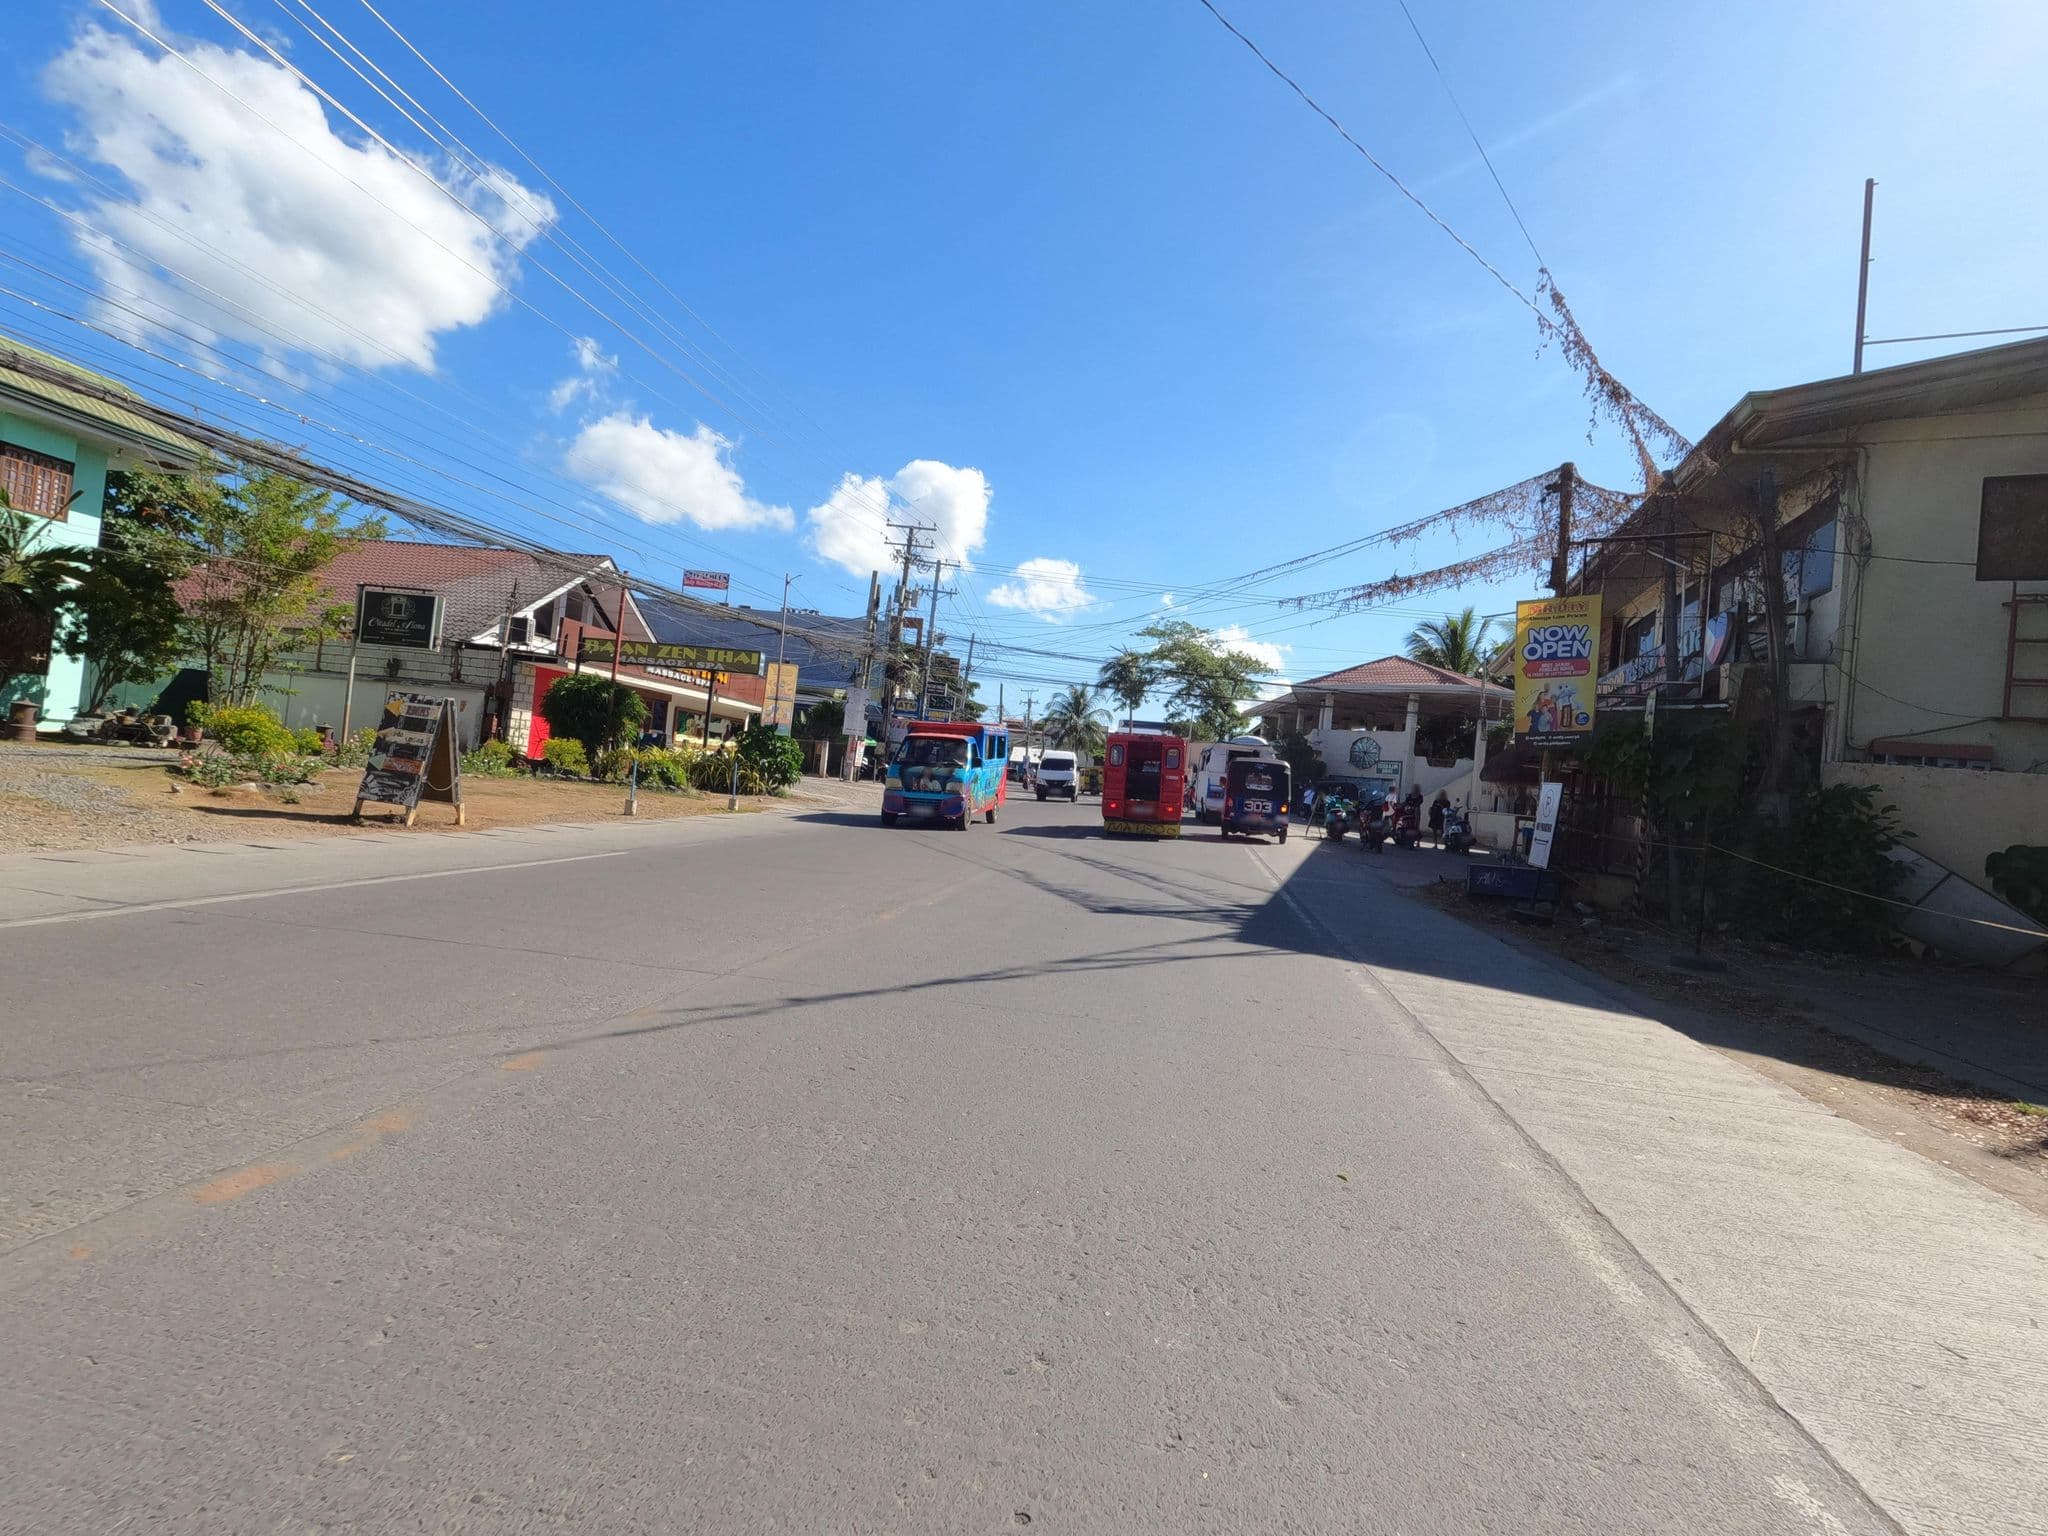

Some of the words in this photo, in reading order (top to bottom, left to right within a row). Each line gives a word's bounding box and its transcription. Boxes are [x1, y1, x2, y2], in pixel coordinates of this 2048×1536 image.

[1528, 625, 1589, 643] NOW
[584, 639, 649, 656] BAAN
[655, 645, 697, 660] ZEN
[705, 649, 759, 666] THAI
[1523, 640, 1592, 660] OPEN
[696, 661, 726, 671] SPA
[897, 701, 917, 710] ATM
[1243, 800, 1273, 814] 303
